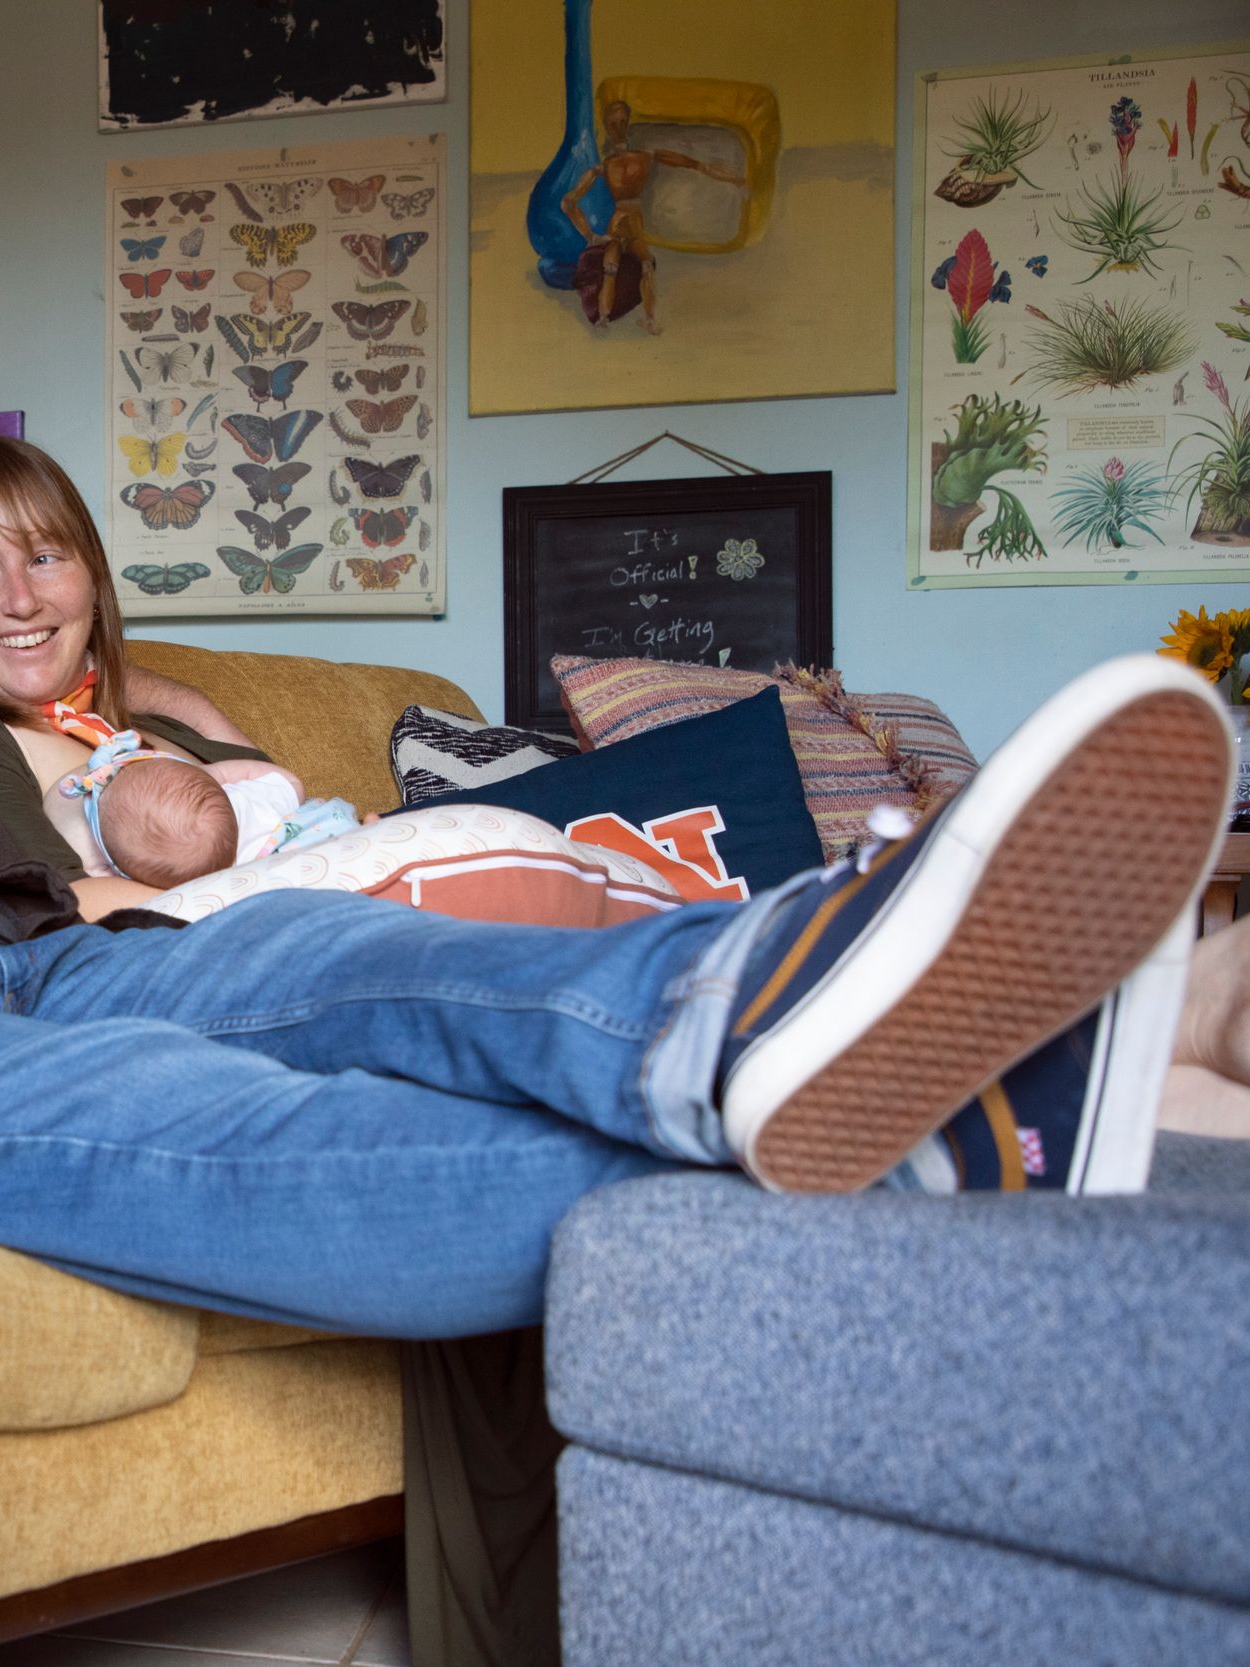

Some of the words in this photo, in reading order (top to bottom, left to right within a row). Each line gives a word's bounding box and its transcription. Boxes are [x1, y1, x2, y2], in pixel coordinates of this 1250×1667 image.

[1088, 69, 1156, 82] TILLANDSIA
[623, 528, 678, 555] It's
[634, 617, 714, 655] Getting
